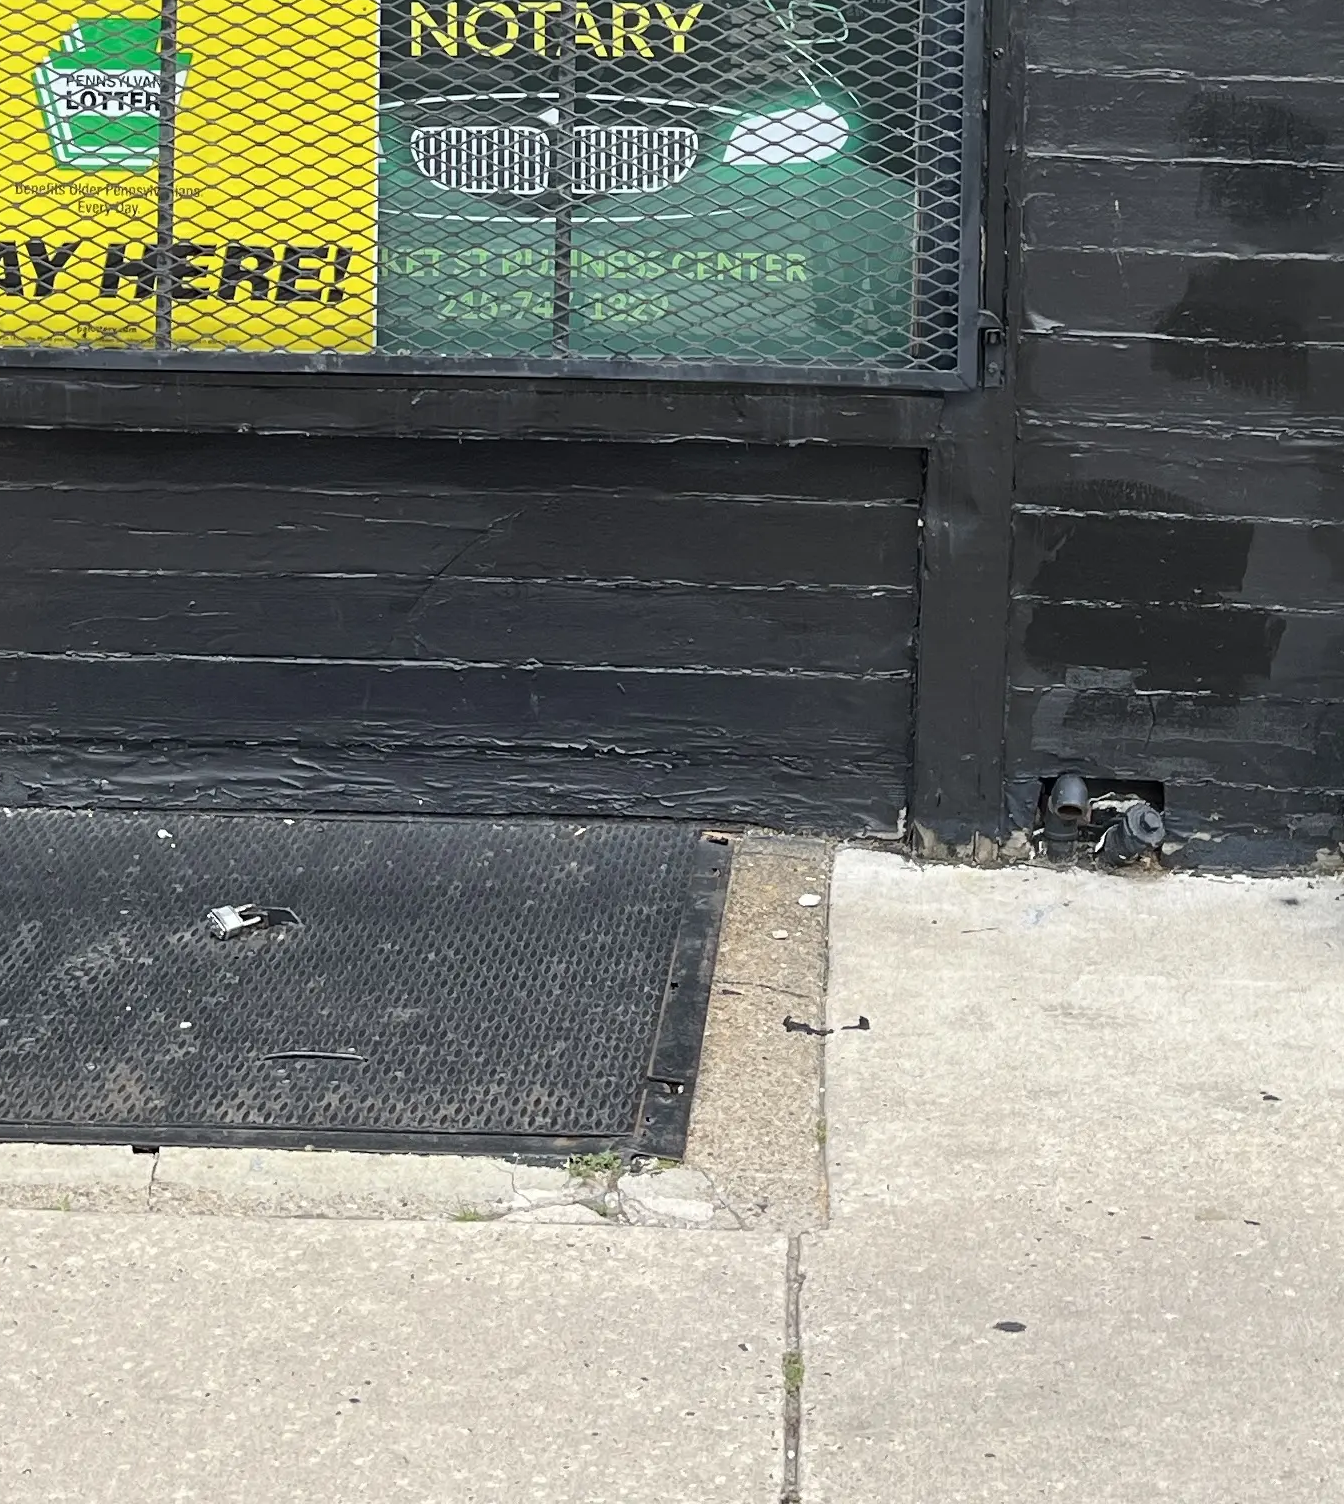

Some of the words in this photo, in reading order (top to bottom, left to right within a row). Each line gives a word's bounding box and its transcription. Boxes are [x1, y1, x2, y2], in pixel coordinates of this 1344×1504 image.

[410, 1, 704, 59] NOTARY
[67, 74, 161, 88] PENNSYLVAN
[67, 91, 160, 111] LOTTER
[100, 243, 353, 302] HERE!
[381, 248, 444, 278] KET
[454, 248, 491, 278] ST
[502, 248, 665, 280] BUINESS
[671, 250, 807, 283] CENTER
[437, 291, 669, 322] 215-74-1329
